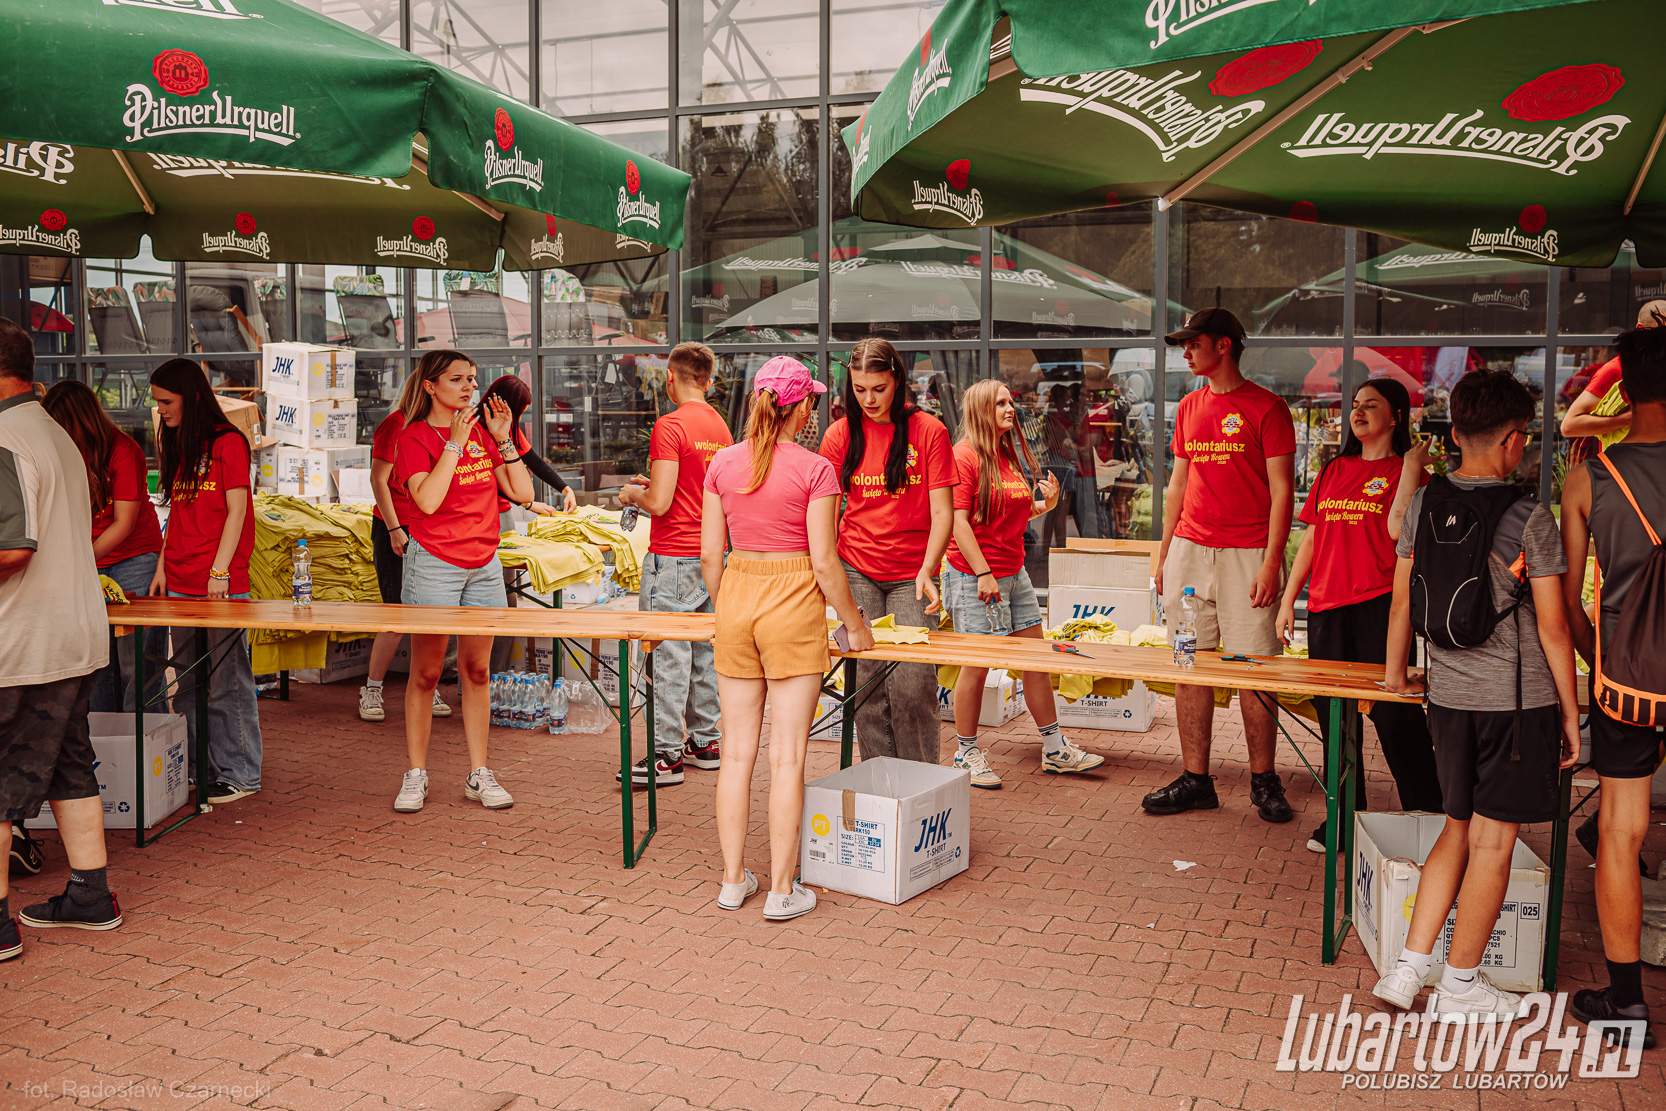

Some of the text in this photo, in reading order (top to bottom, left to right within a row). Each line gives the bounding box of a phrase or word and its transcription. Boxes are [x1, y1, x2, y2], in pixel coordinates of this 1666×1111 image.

[272, 356, 294, 375] JHK
[276, 405, 297, 424] JHK
[914, 808, 952, 852] JHK
[926, 843, 946, 858] T-SHIRT
[1522, 906, 1538, 916] 025
